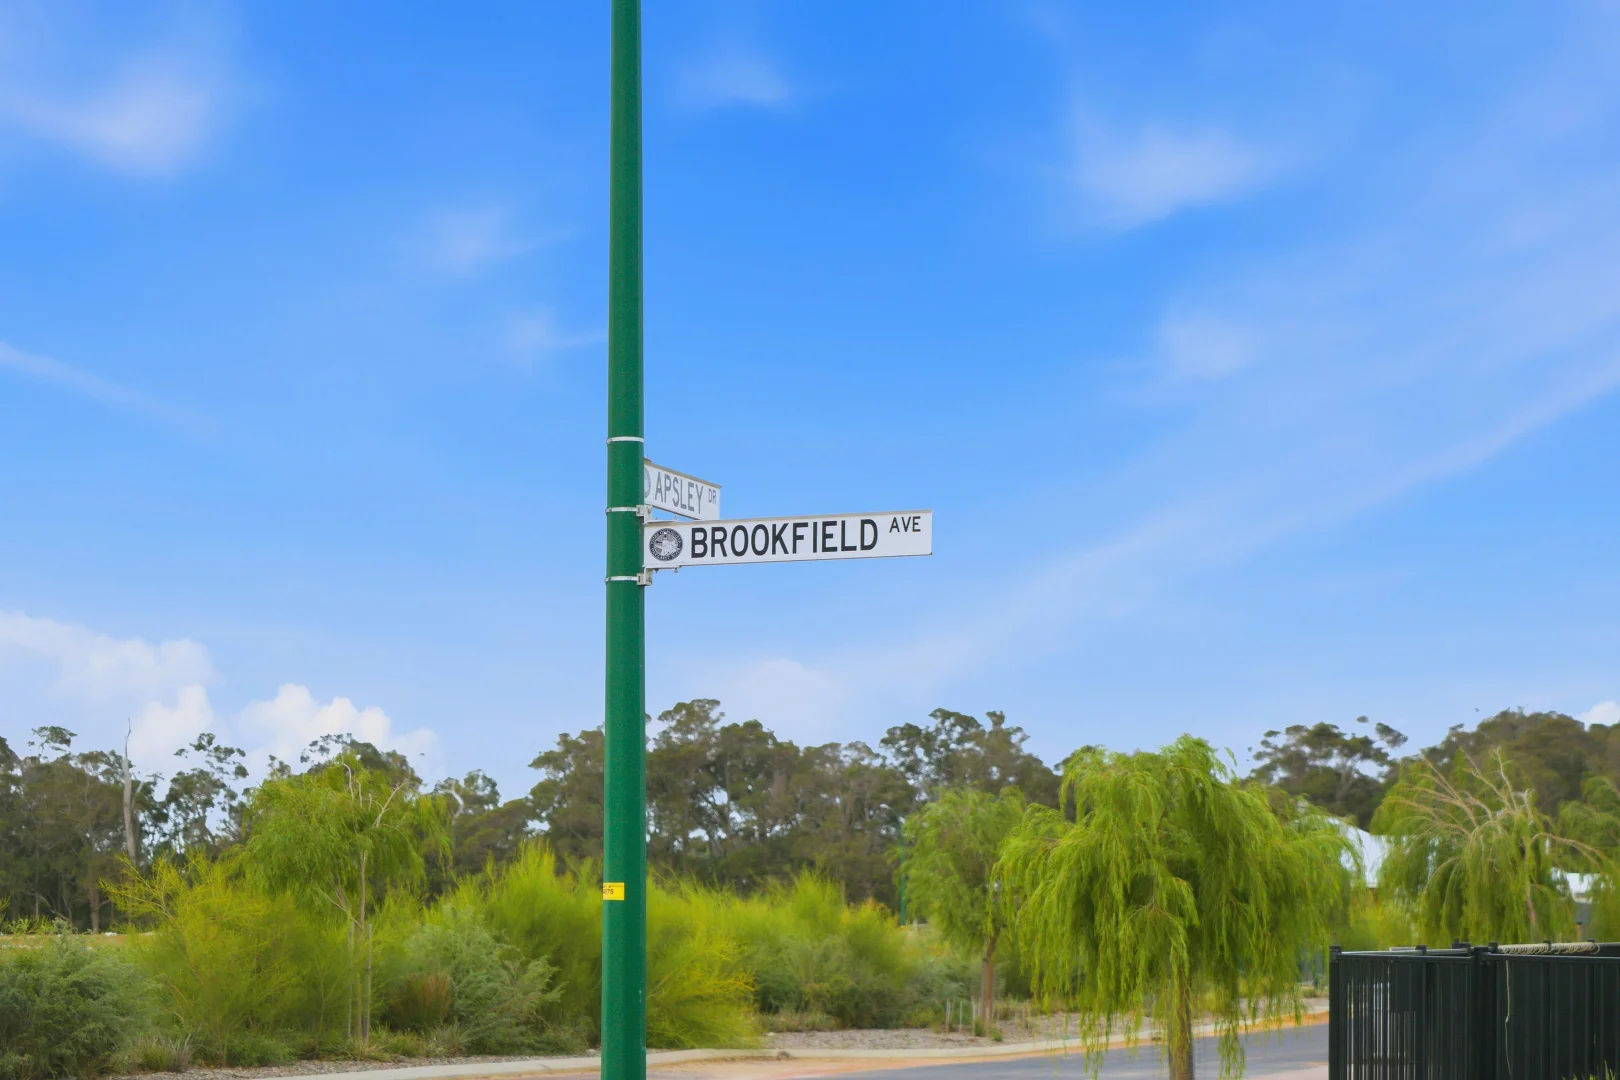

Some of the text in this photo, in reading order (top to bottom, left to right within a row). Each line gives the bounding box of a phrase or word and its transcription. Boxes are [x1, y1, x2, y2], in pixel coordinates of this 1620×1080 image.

[655, 471, 717, 514] APSLEY DR
[691, 518, 879, 559] BROOKFIELD
[889, 516, 921, 533] AVE
